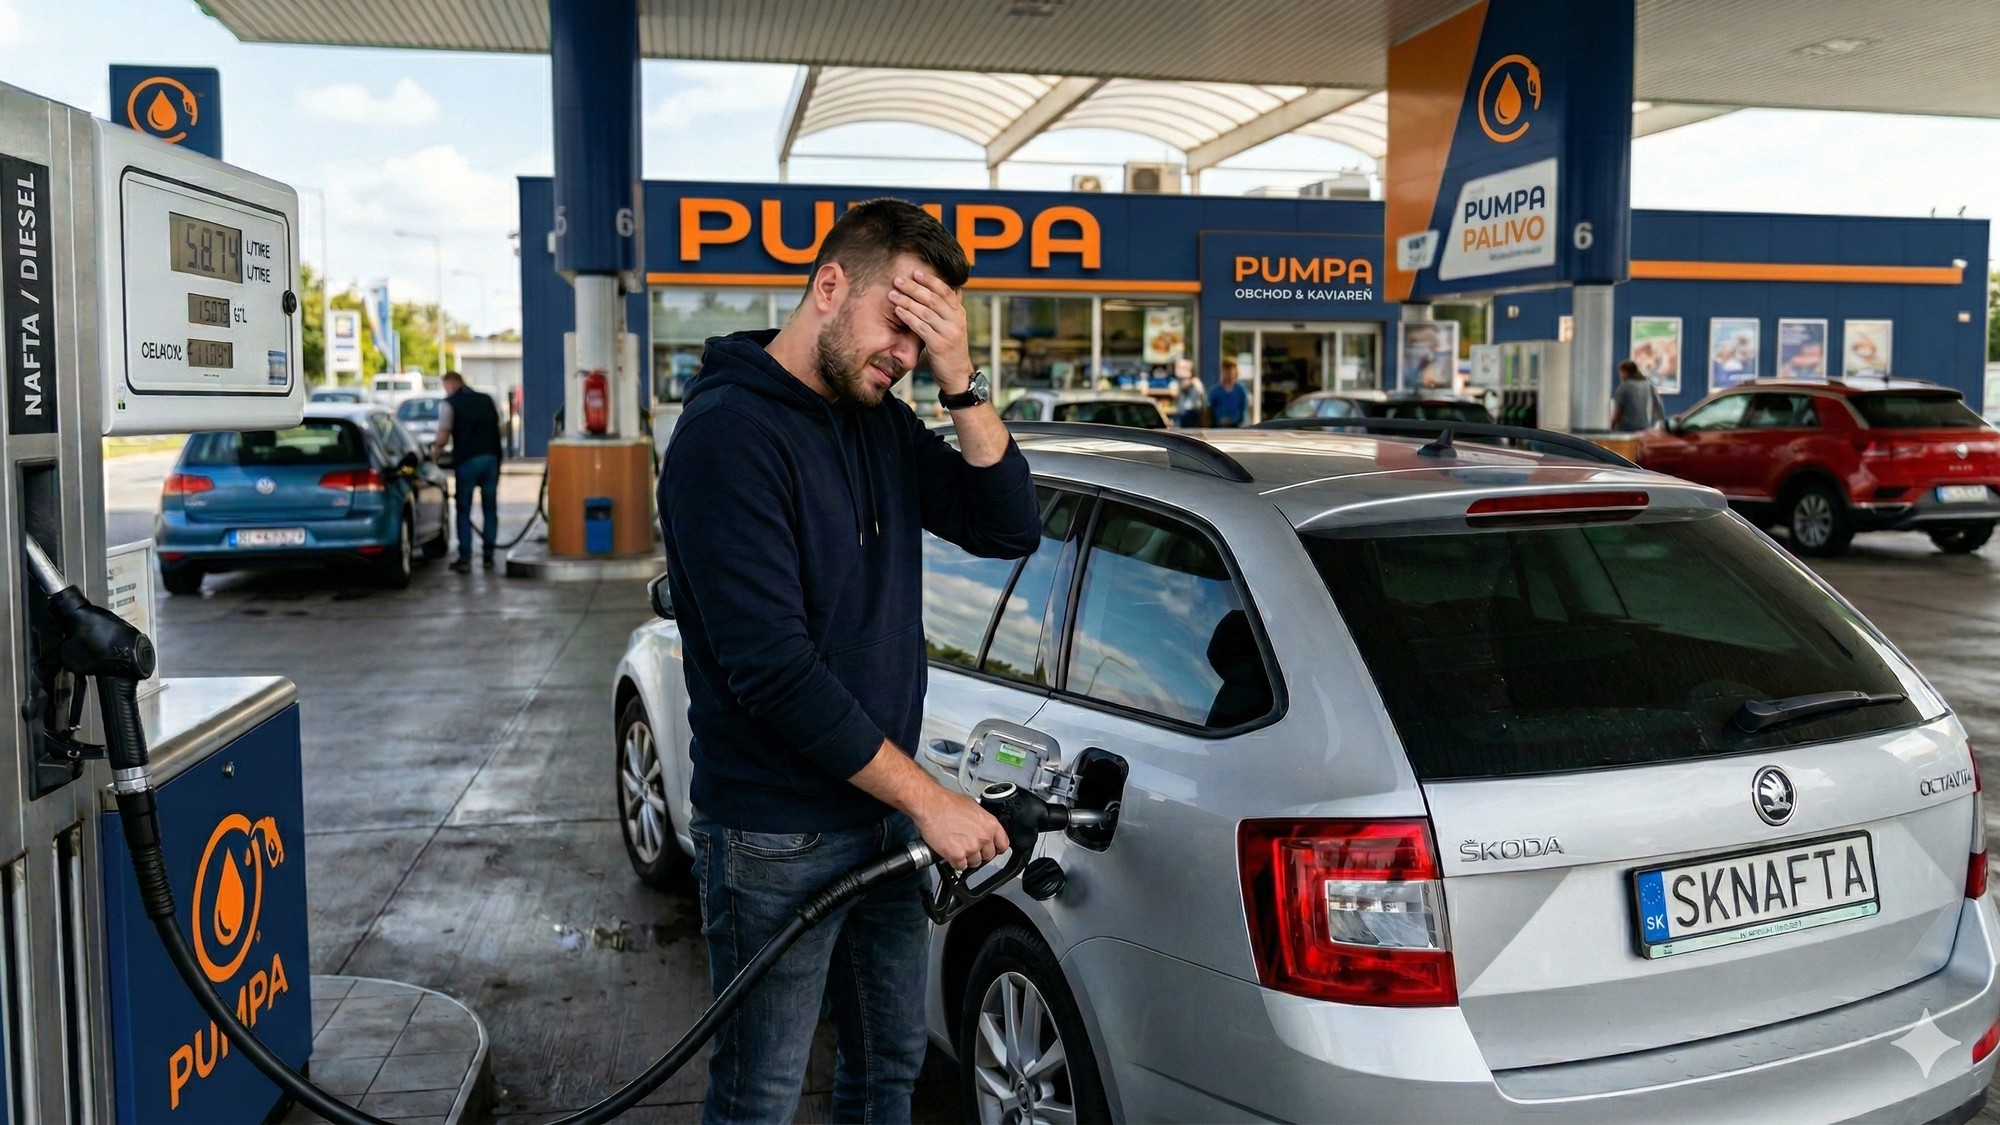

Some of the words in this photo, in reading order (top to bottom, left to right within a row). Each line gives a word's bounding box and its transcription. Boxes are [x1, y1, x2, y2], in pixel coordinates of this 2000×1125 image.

[1464, 185, 1545, 224] PUMPA
[17, 172, 38, 281] DIESEL
[615, 208, 634, 238] 6
[680, 197, 1101, 269] PUPA
[1463, 215, 1545, 253] PALIVO
[1573, 222, 1594, 250] 6
[1235, 256, 1373, 285] PUMPA
[20, 288, 40, 304] /
[1234, 288, 1293, 299] OBCHOD
[1295, 289, 1305, 300] &
[1307, 287, 1373, 301] KAVIAREŇ
[21, 313, 42, 416] NAFTA
[1459, 836, 1565, 863] ŠKODA
[1672, 845, 1868, 928] SKNAFTA
[1646, 913, 1666, 931] SK
